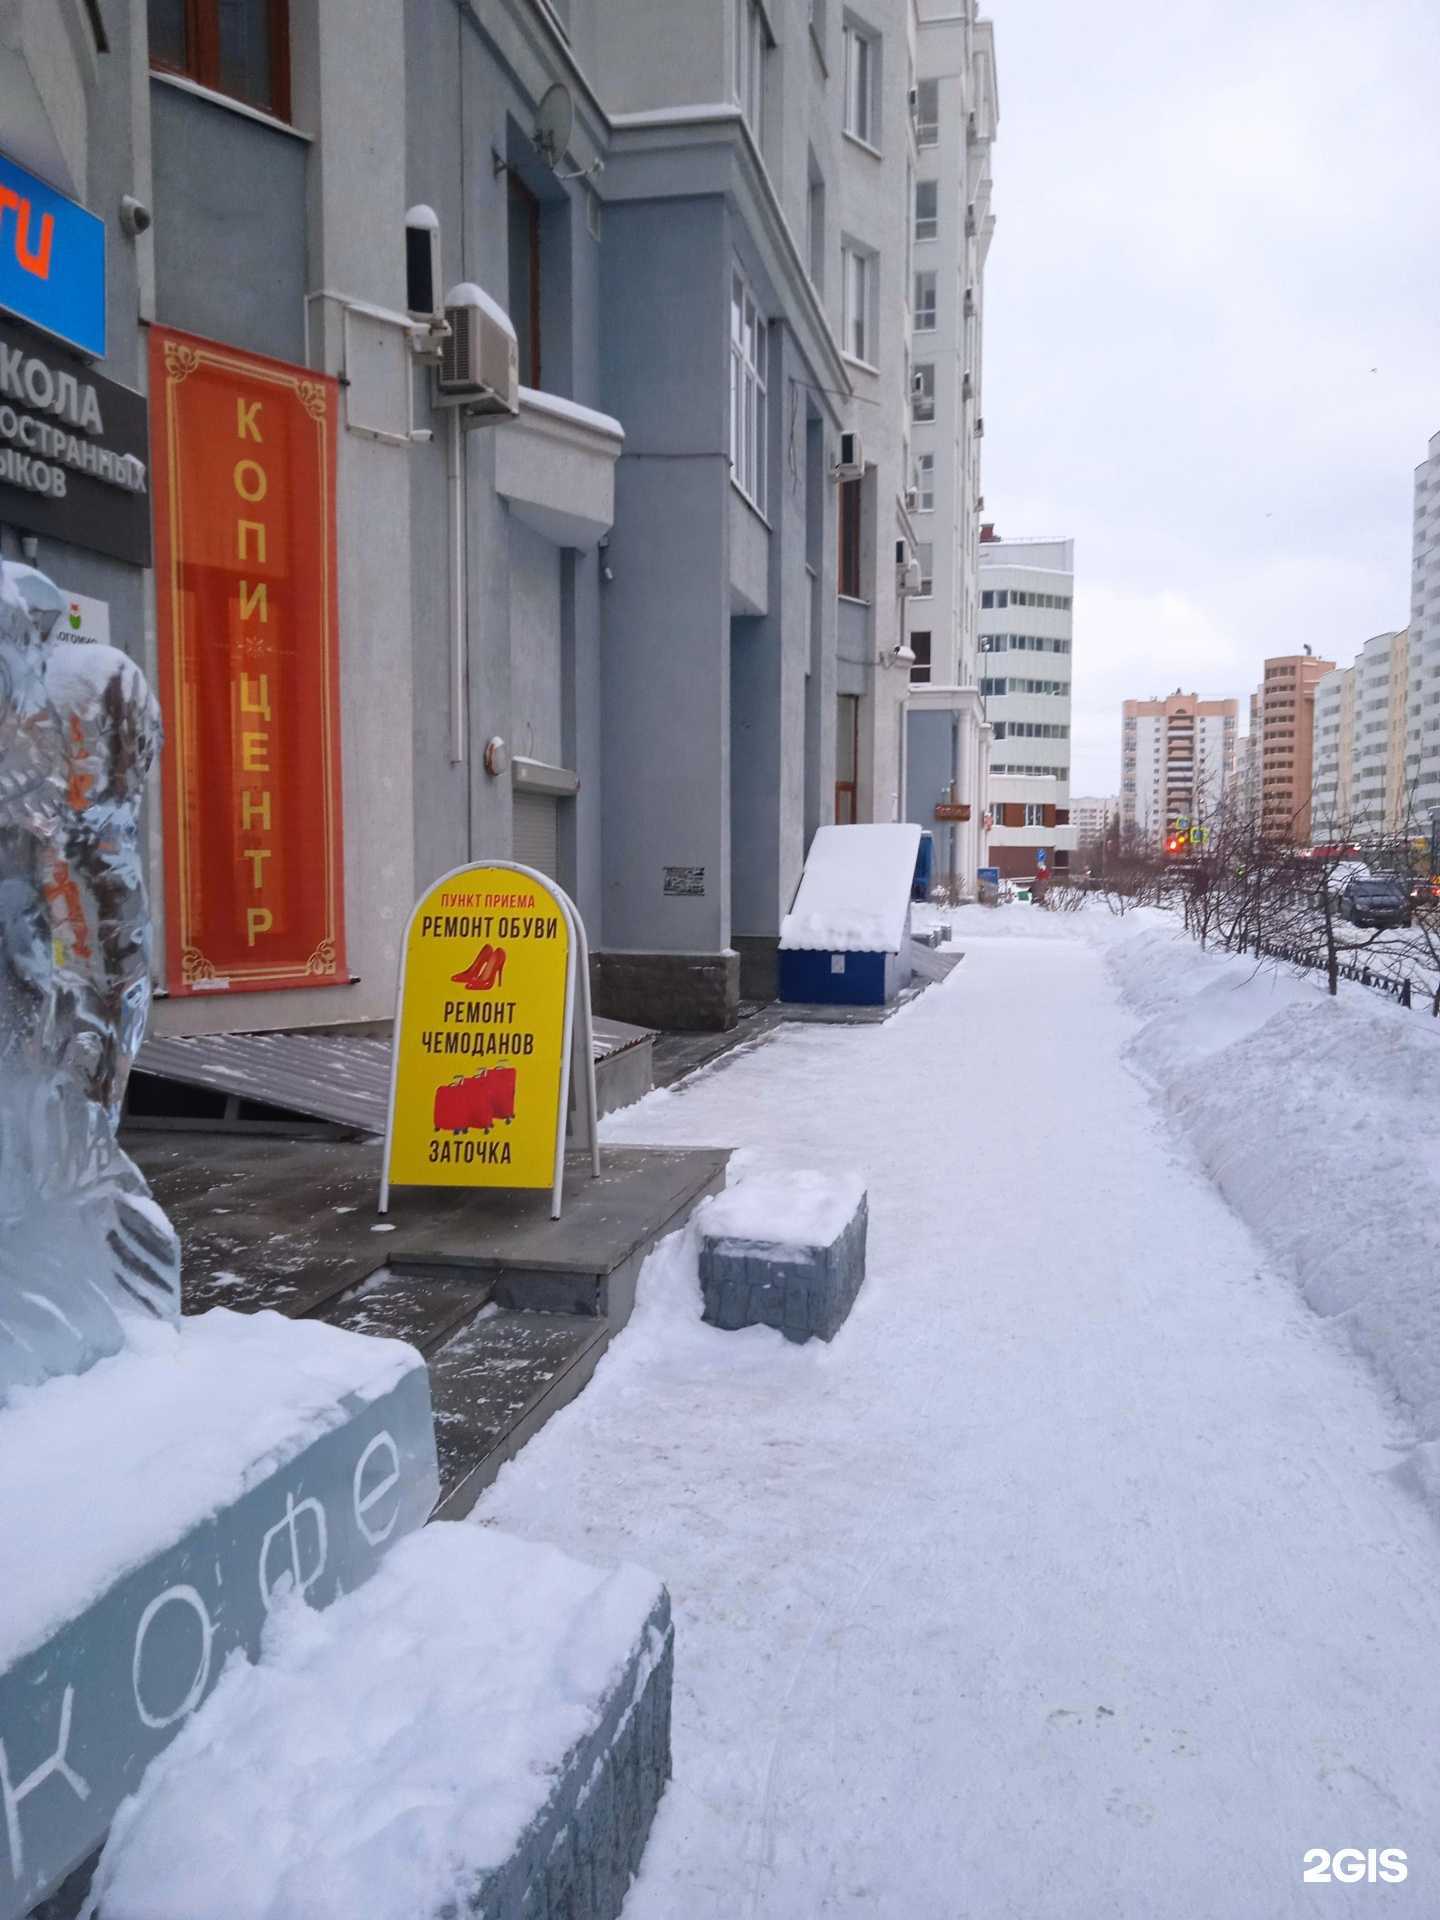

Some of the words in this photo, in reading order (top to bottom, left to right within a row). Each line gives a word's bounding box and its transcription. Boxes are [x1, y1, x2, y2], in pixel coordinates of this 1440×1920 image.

[233, 397, 268, 624] КОПИ
[240, 671, 273, 947] ЦЕНТР
[441, 893, 482, 908] ПУНКТ
[484, 895, 535, 908] ПРИЕМА
[422, 916, 494, 938] РЕМОНТ
[498, 917, 558, 939] ОБУВИ
[444, 1001, 516, 1024] РЕМОНТ
[422, 1031, 534, 1057] ЧЕМОДАНОВ
[428, 1140, 512, 1164] ЗАТОЧКА
